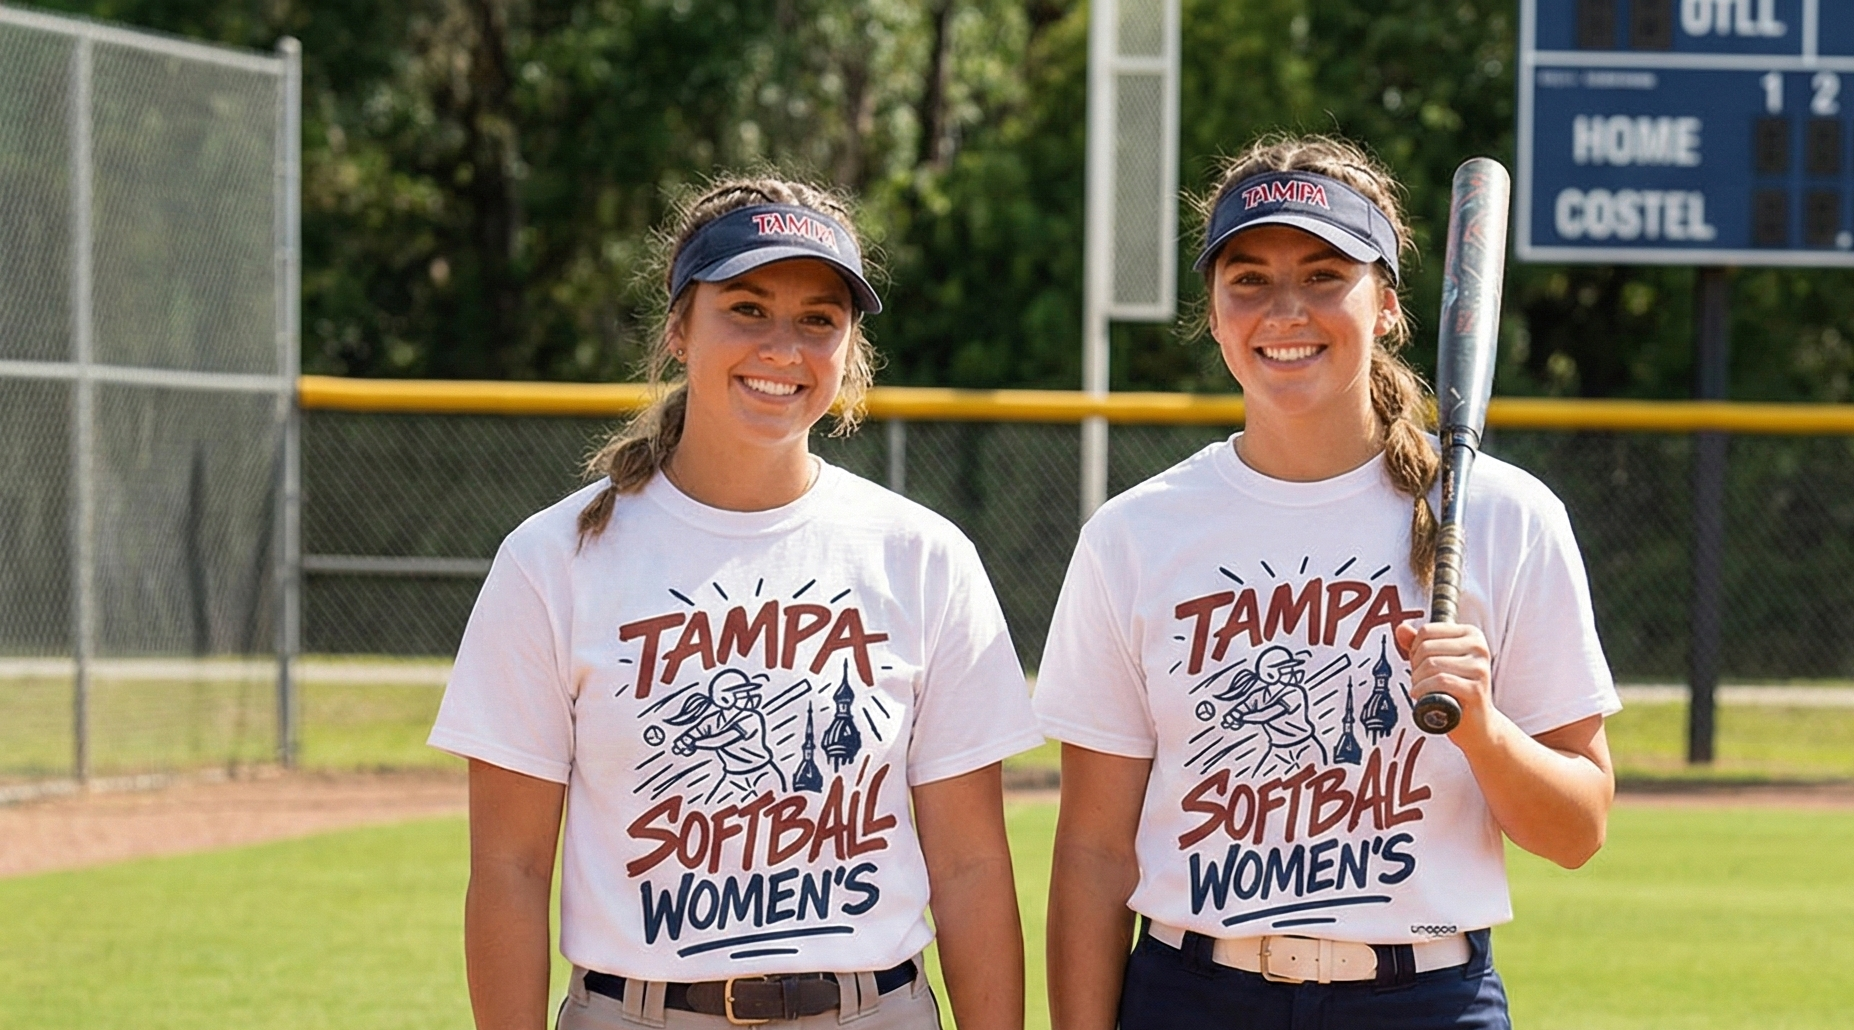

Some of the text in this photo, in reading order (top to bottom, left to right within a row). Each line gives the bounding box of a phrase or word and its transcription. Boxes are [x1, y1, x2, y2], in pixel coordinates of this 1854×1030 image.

[1760, 71, 1841, 116] 1 2
[1572, 115, 1702, 166] HOME
[1242, 180, 1330, 210] TAMPA
[1555, 188, 1716, 241] COSTEL
[619, 600, 889, 699] TAMPA
[1175, 578, 1424, 675] TAMPA
[626, 756, 898, 878] SOFTBALL
[1178, 730, 1432, 850] SOFTBALL
[640, 863, 880, 944] WOMEN'S
[1189, 833, 1416, 915] WOMEN'S
